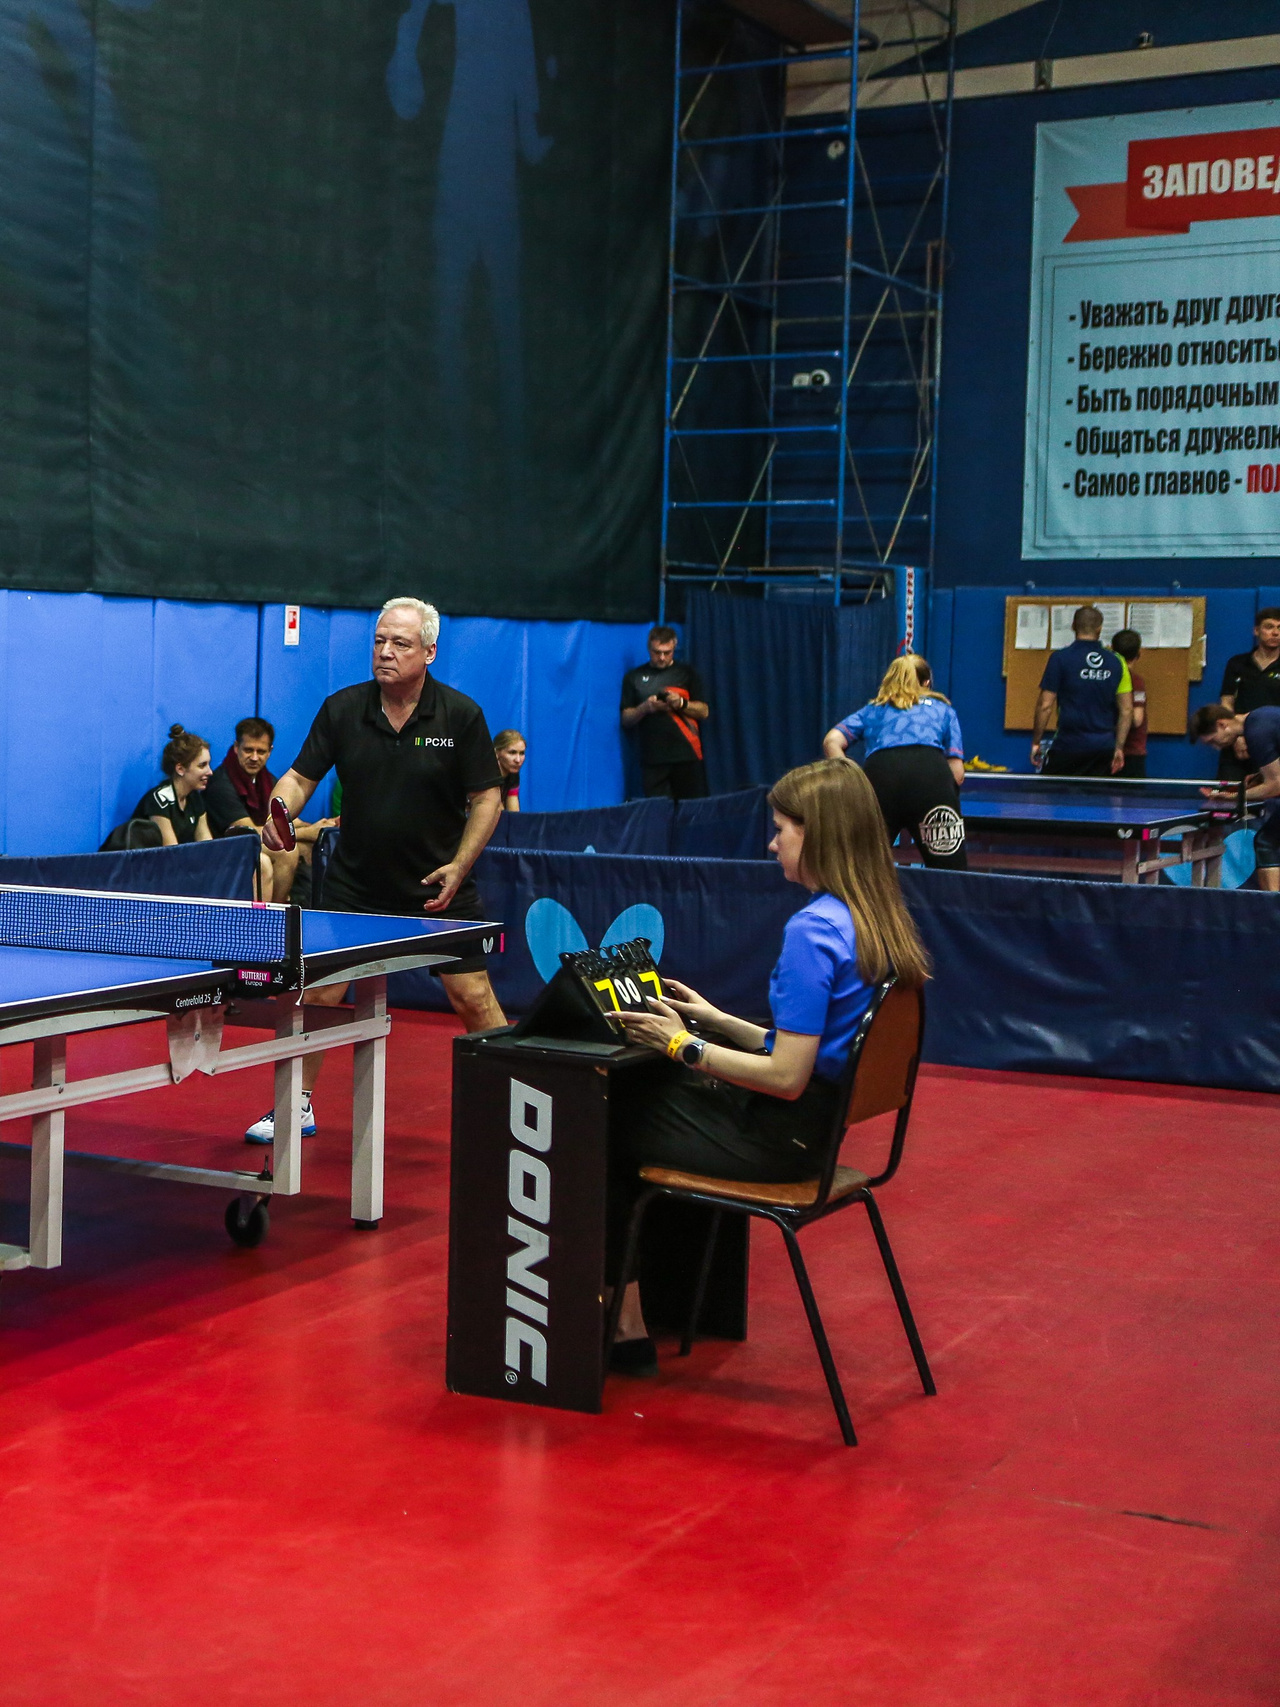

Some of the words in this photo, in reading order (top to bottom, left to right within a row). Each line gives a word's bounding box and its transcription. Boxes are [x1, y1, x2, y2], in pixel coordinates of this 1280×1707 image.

[1143, 155, 1280, 199] ЗАПОВЕ
[1080, 299, 1169, 330] Уважать
[1173, 297, 1223, 328] друг
[1078, 342, 1173, 374] Бережно
[1177, 337, 1280, 367] относить
[1077, 384, 1132, 413] Быть
[1136, 380, 1280, 413] порядочным
[1076, 426, 1181, 458] Общаться
[1074, 468, 1141, 498] Самое
[1144, 469, 1231, 496] главное
[424, 737, 455, 747] РСХБ
[919, 818, 966, 843] MIAMI
[241, 970, 268, 981] BUTTERFLY
[175, 993, 204, 1008] Centrefold
[204, 993, 211, 1003] 25
[505, 1076, 553, 1387] DONIC
